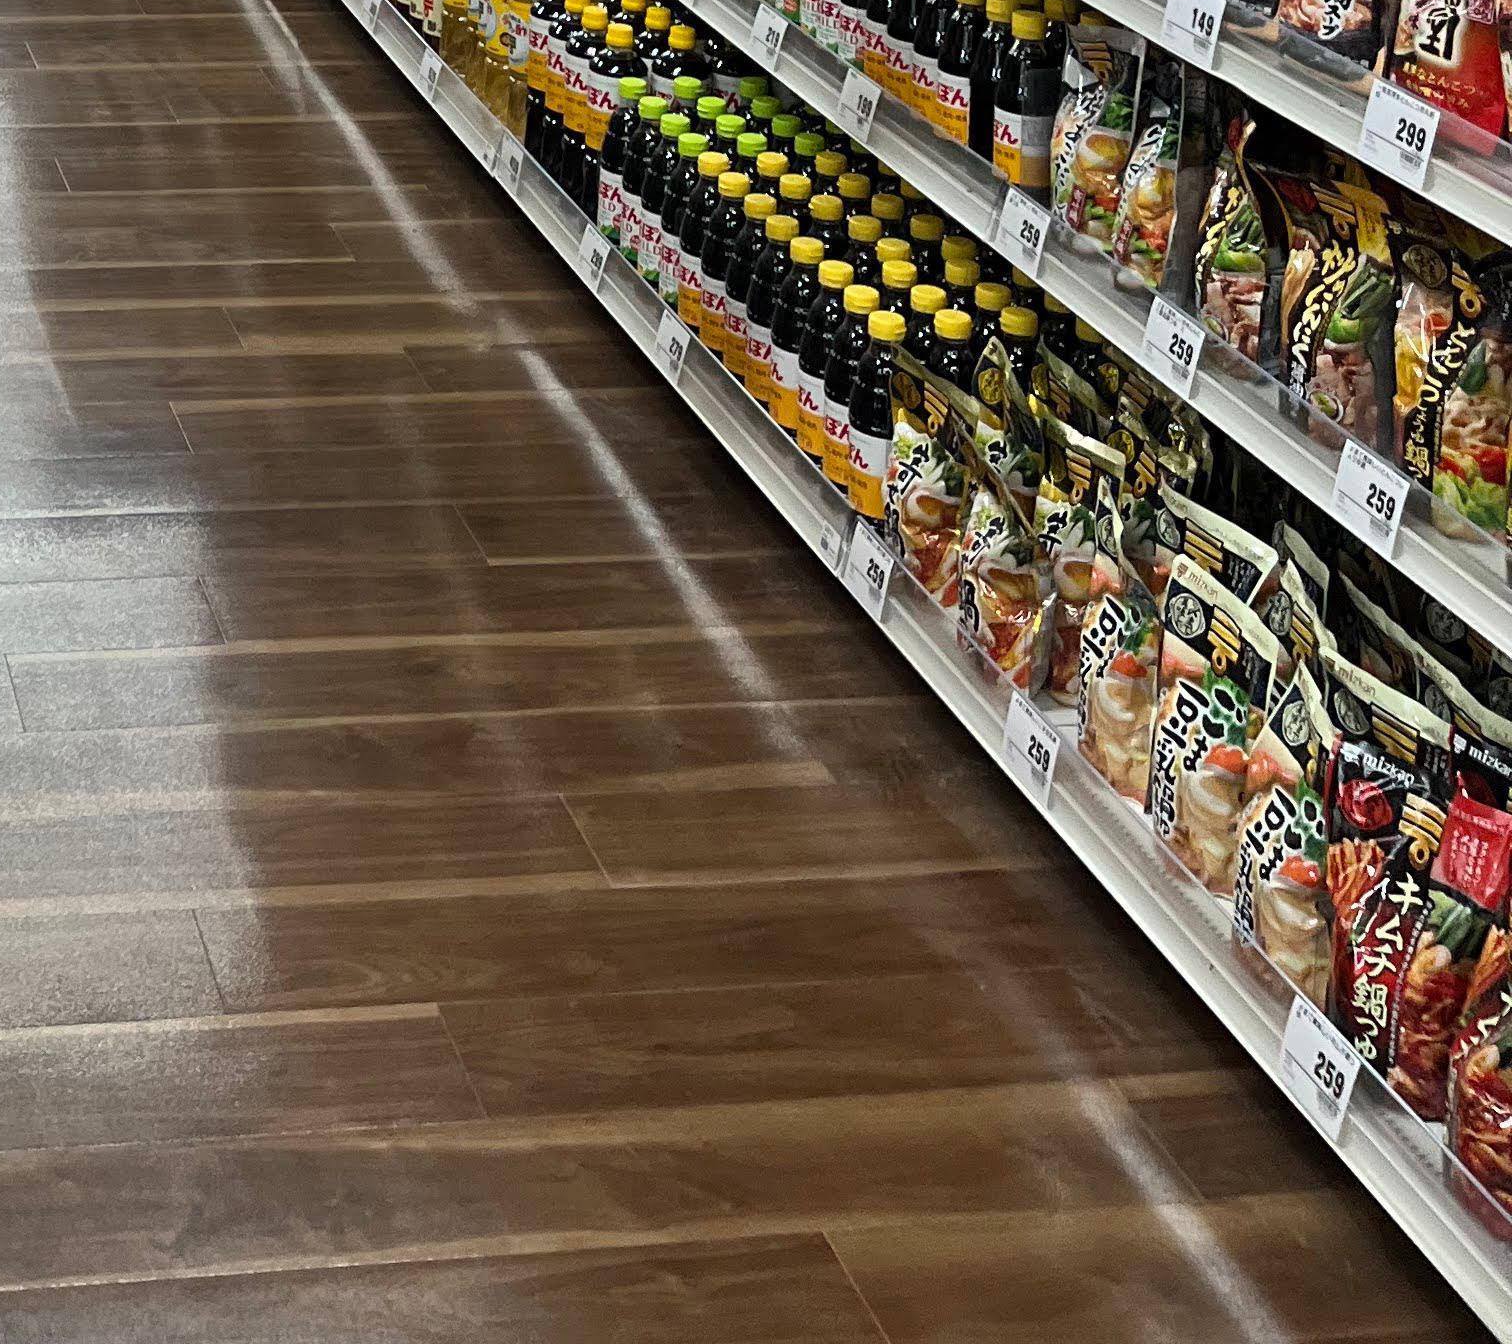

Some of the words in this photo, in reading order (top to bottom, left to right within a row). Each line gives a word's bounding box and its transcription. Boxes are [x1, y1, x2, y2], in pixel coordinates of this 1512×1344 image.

[1190, 9, 1215, 36] 149
[1396, 118, 1426, 152] 299
[1020, 220, 1040, 248] 259
[1168, 333, 1194, 365] 259
[1365, 483, 1396, 521] 259
[865, 559, 884, 591] 259
[1188, 569, 1219, 601] mizkan
[1025, 742, 1051, 773] 259
[1363, 751, 1415, 785] mizkan
[1351, 872, 1425, 1061] キムチ鍋つゆ
[1313, 1050, 1346, 1100] 259
